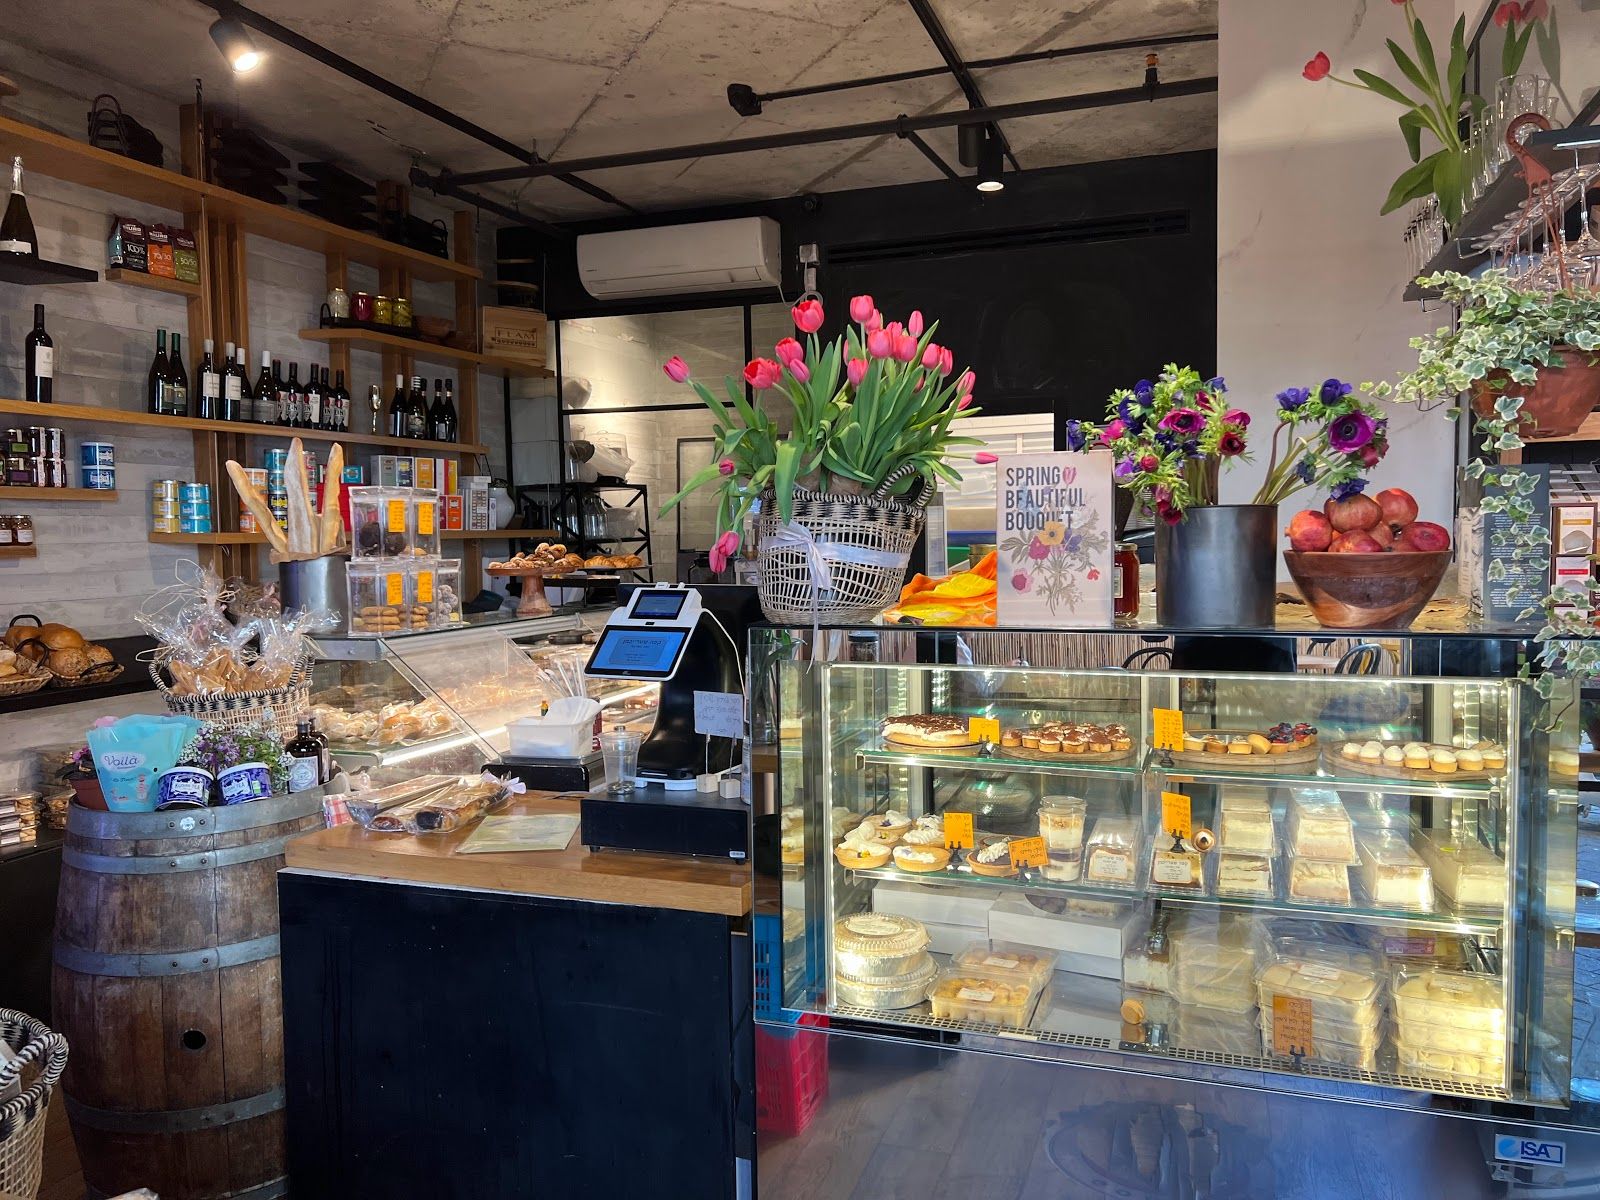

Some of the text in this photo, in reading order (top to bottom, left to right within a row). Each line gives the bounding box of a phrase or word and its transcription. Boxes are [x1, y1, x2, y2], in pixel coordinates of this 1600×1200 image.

[127, 244, 145, 254] 100%
[1006, 466, 1060, 486] SPRING
[1006, 488, 1086, 509] BEAUTIFUL
[1520, 1140, 1550, 1158] ISA
